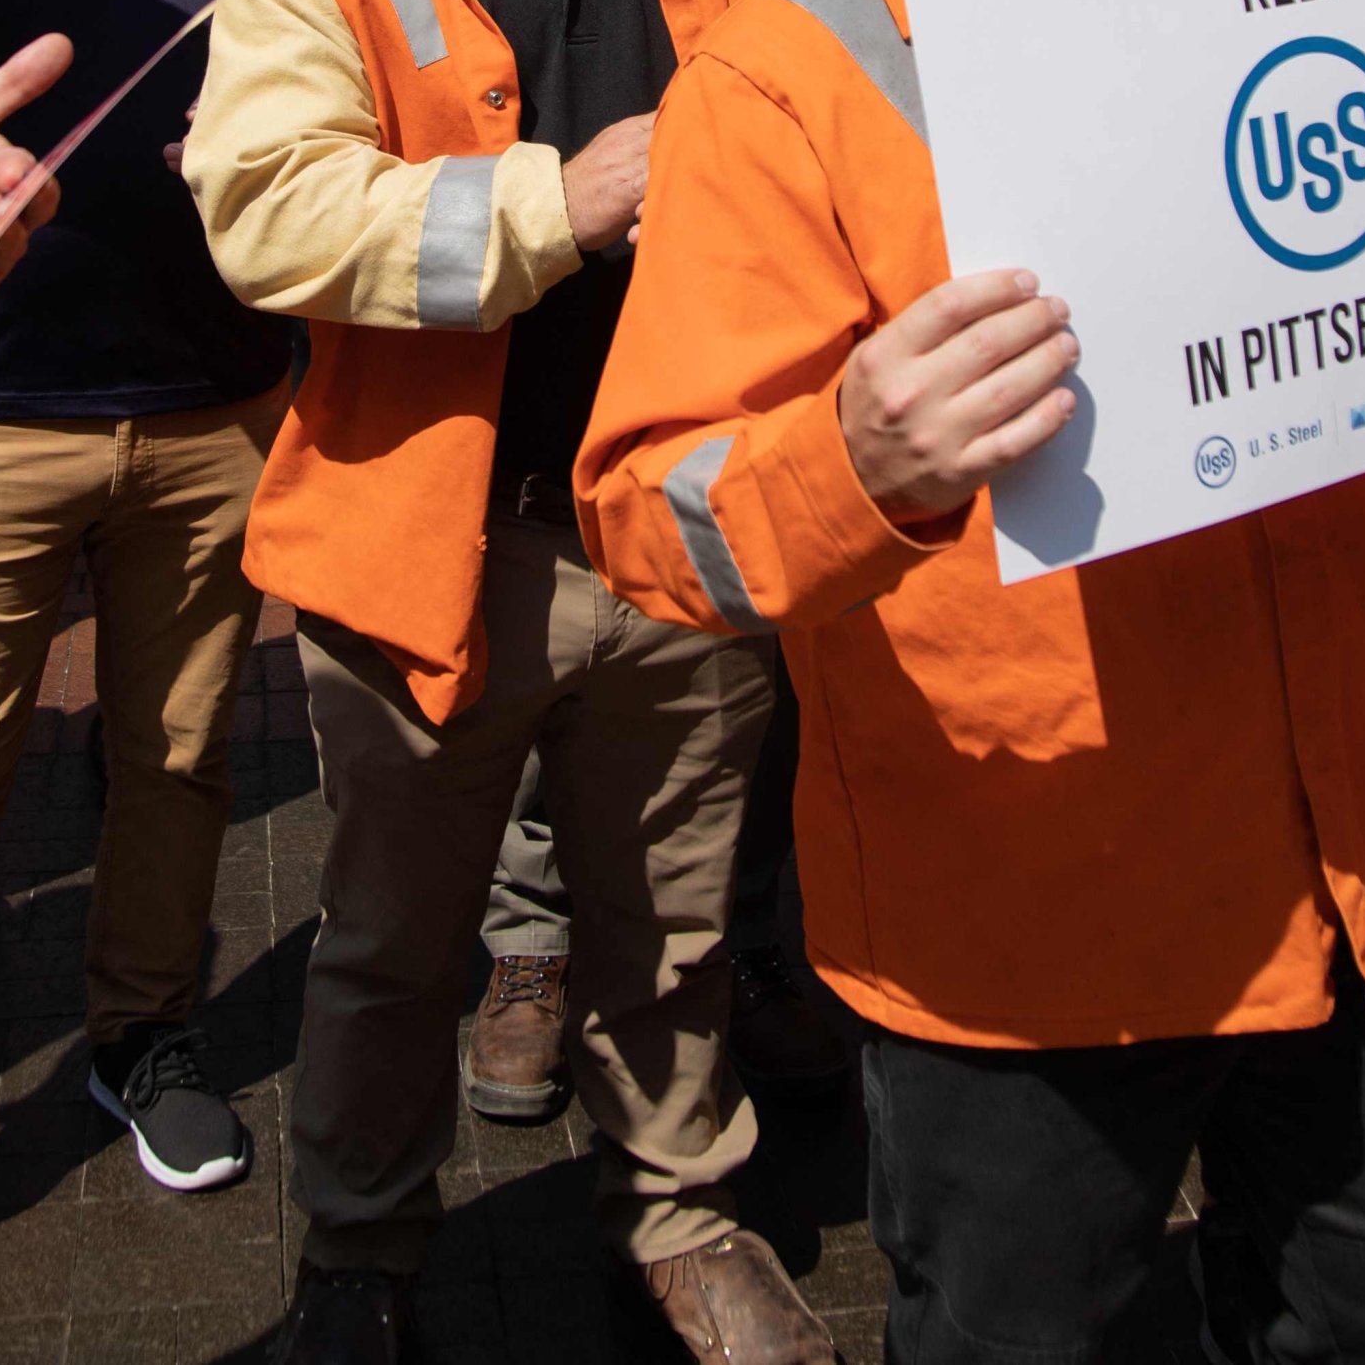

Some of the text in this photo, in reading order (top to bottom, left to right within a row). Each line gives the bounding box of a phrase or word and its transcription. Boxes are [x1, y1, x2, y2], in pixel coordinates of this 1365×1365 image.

[1185, 337, 1230, 407] IN
[1249, 440, 1265, 459] U.
[1269, 433, 1285, 453] S.
[1288, 419, 1324, 448] Steel
